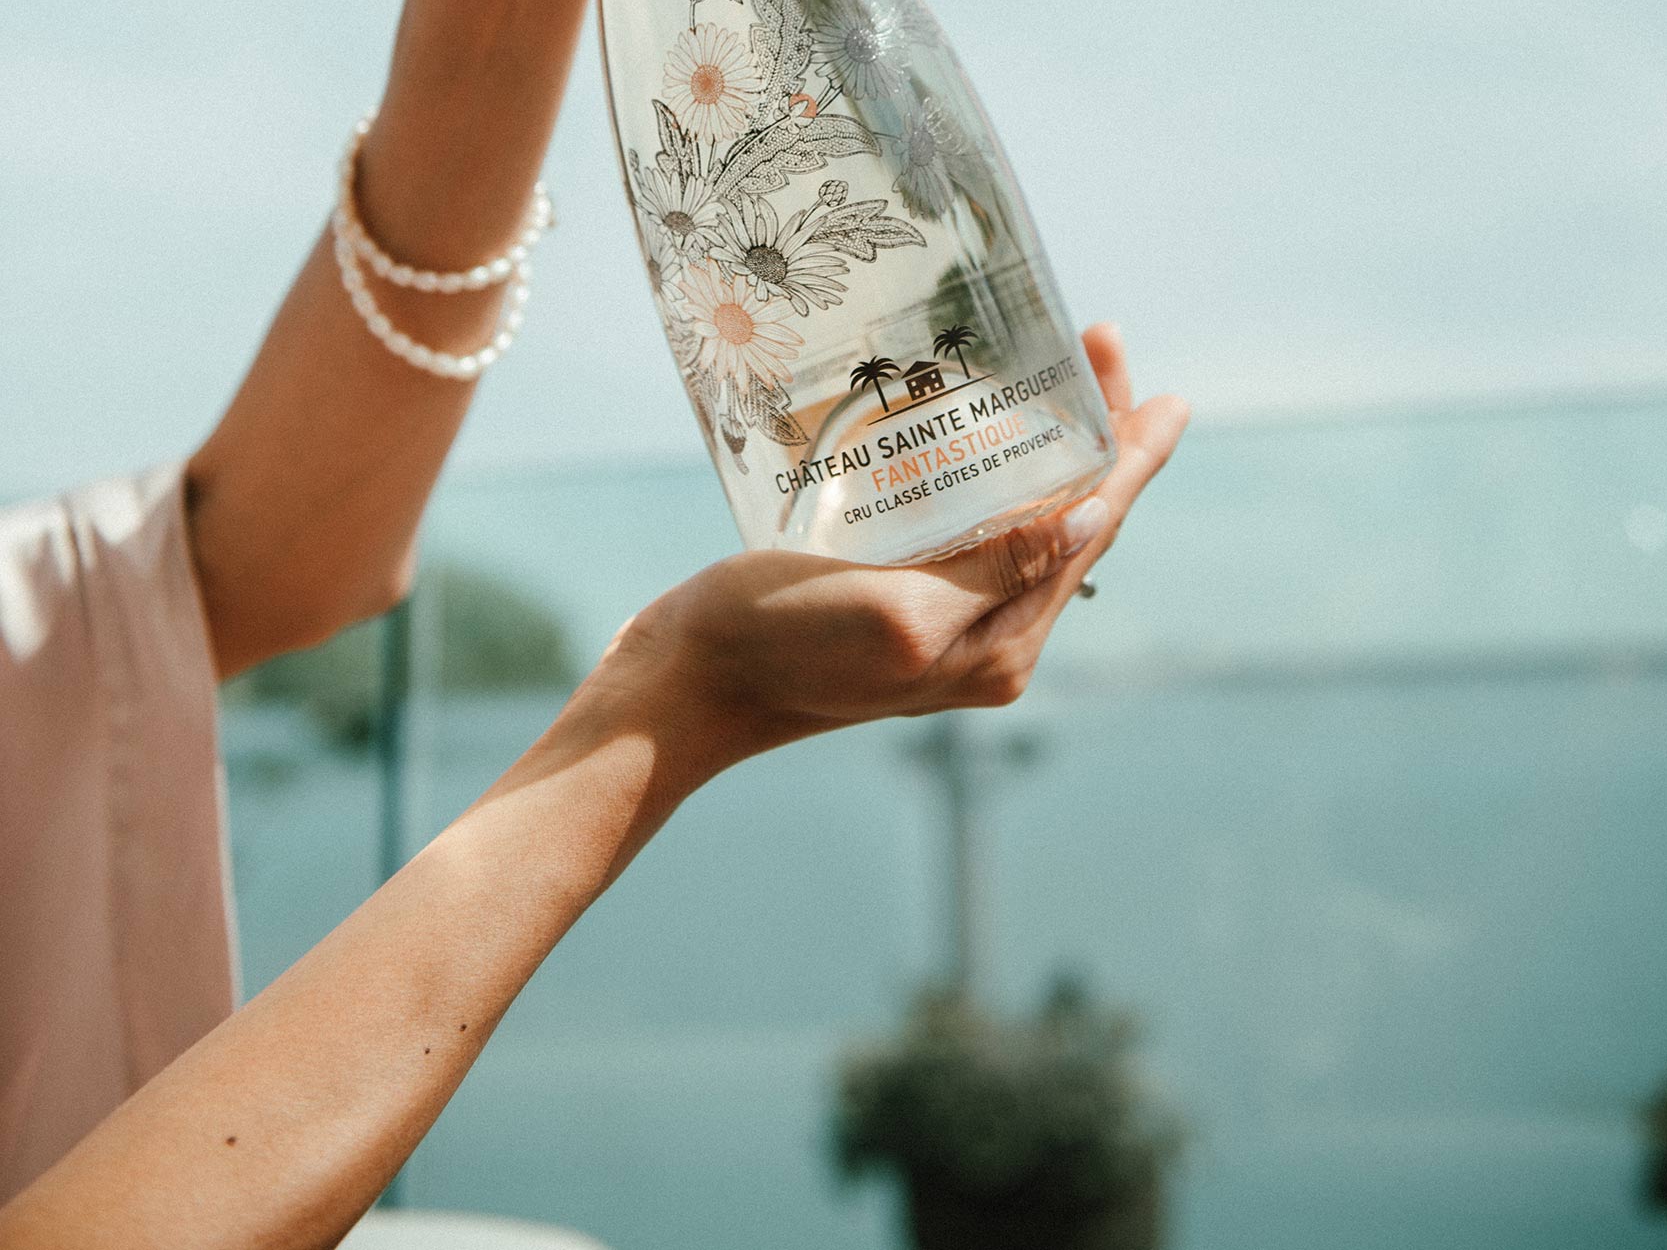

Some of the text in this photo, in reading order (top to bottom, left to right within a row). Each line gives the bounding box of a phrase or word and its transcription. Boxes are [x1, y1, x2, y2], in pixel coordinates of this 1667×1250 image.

[775, 356, 1078, 494] CHÂTEAU SAINTE MARGUERITE
[844, 425, 1064, 524] CRU CLASSÉ CÔTES DE PROVENCE
[871, 412, 1029, 492] FANTASTIQUE
